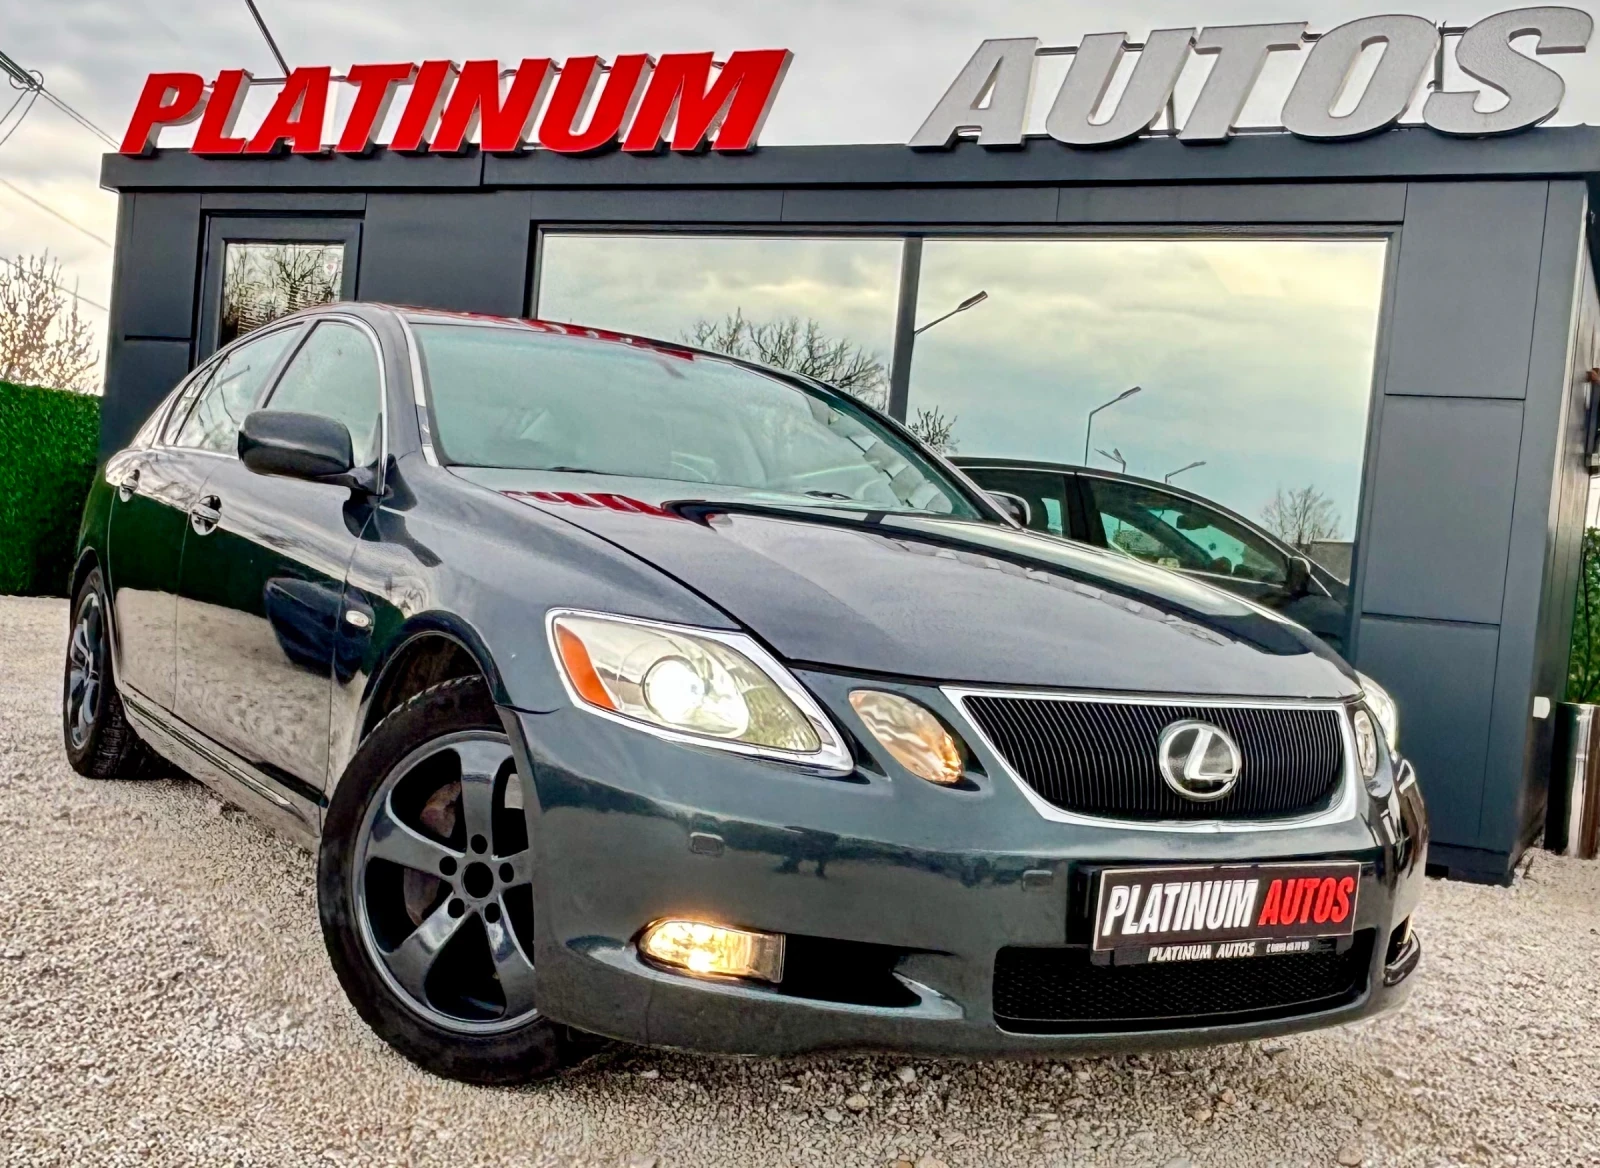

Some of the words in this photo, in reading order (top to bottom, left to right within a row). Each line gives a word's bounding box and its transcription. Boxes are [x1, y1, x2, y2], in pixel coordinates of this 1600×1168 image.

[119, 47, 793, 156] PLATINUM
[906, 6, 1594, 148] AUTOS
[1101, 878, 1259, 937] PLATINUM
[1258, 877, 1355, 926] AUTOS
[1148, 944, 1212, 962] PLATINUM
[1216, 941, 1256, 959] AUTOS
